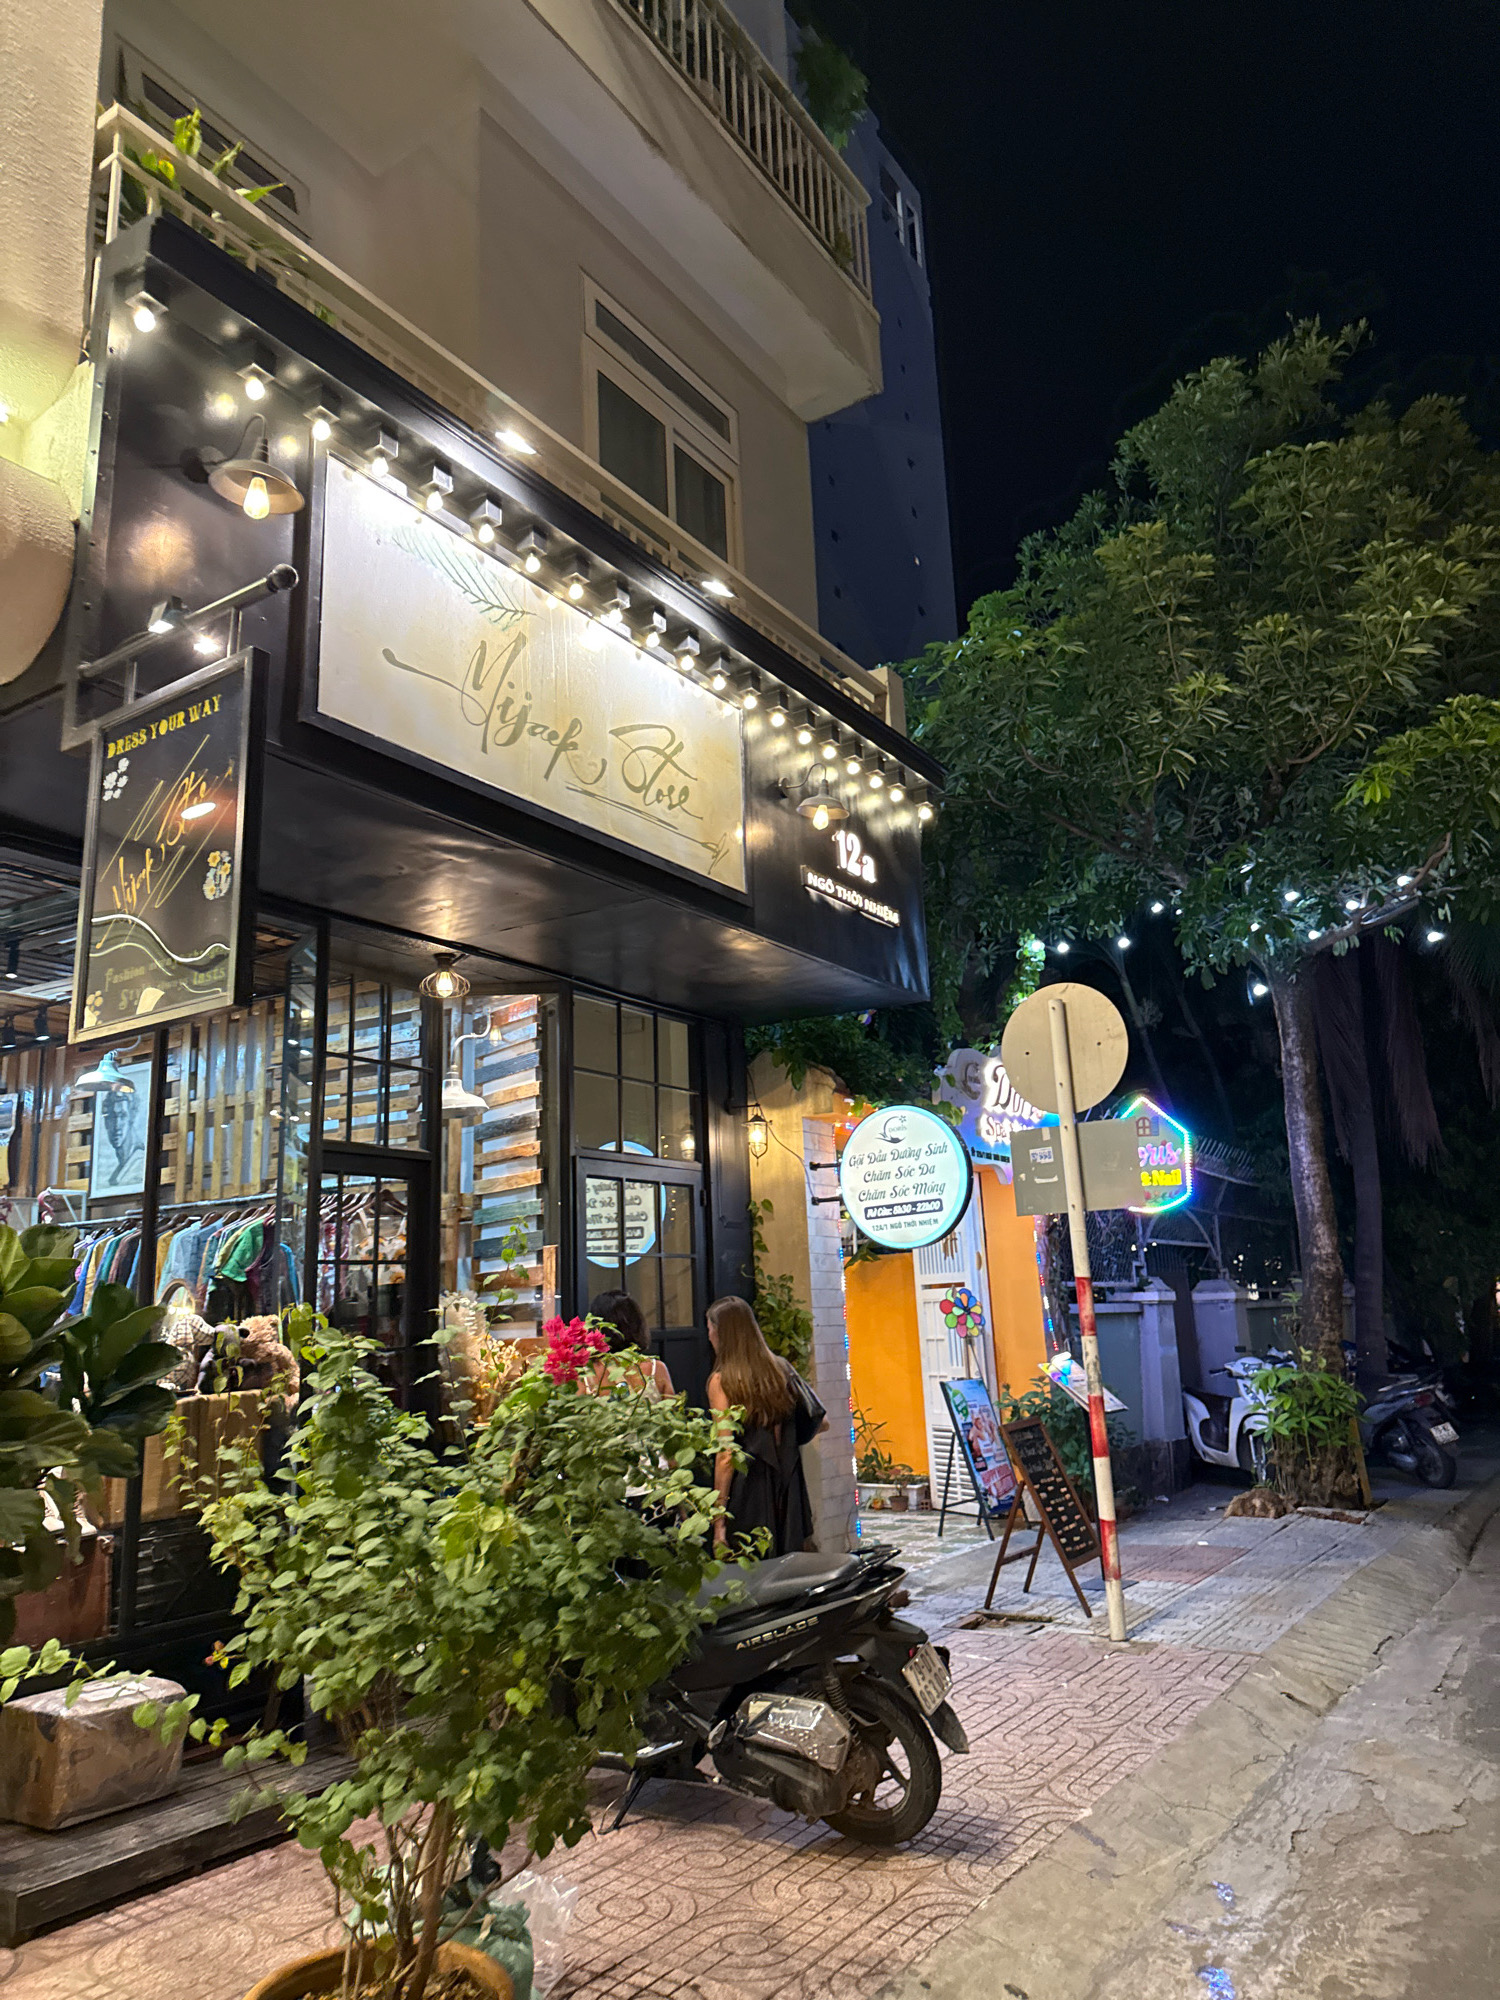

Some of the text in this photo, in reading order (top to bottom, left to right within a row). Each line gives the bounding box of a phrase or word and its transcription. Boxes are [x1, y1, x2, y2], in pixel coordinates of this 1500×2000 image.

[107, 694, 222, 758] DRESS YOUR WAY
[609, 723, 703, 820] Store
[807, 872, 835, 893] NGÔ
[925, 1142, 948, 1156] Sinh
[863, 1163, 935, 1183] Chăm Sóc Da
[858, 1189, 886, 1202] Chăm
[889, 1185, 910, 1199] Sóc
